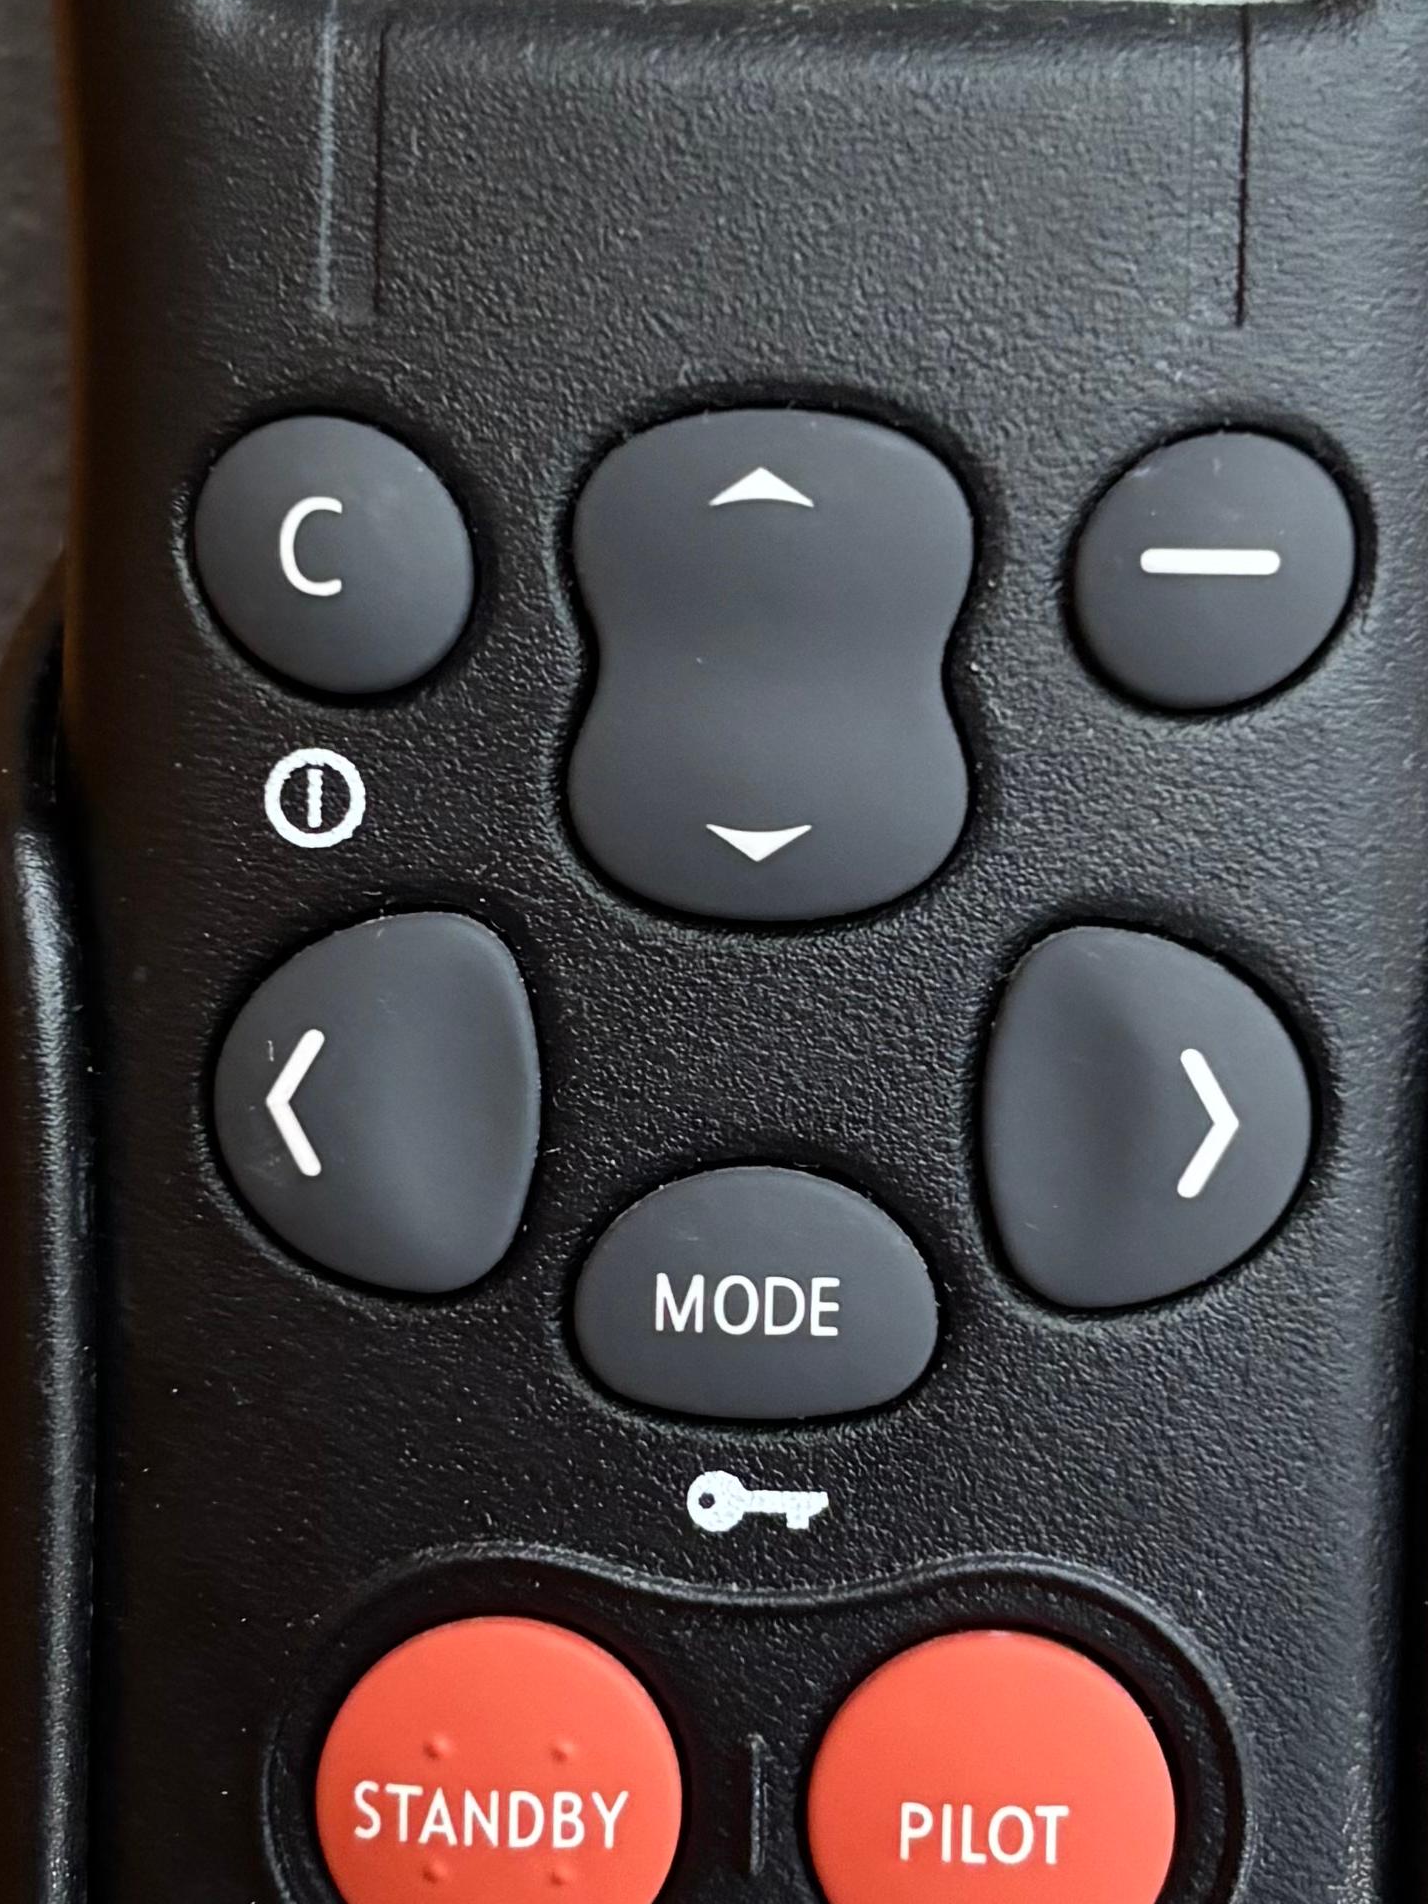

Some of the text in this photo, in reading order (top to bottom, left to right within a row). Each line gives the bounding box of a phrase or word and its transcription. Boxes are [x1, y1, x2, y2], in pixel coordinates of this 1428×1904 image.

[279, 496, 343, 597] C
[655, 1272, 842, 1337] MODE
[353, 1780, 630, 1851] STANDBY
[899, 1801, 1072, 1866] PILOT
